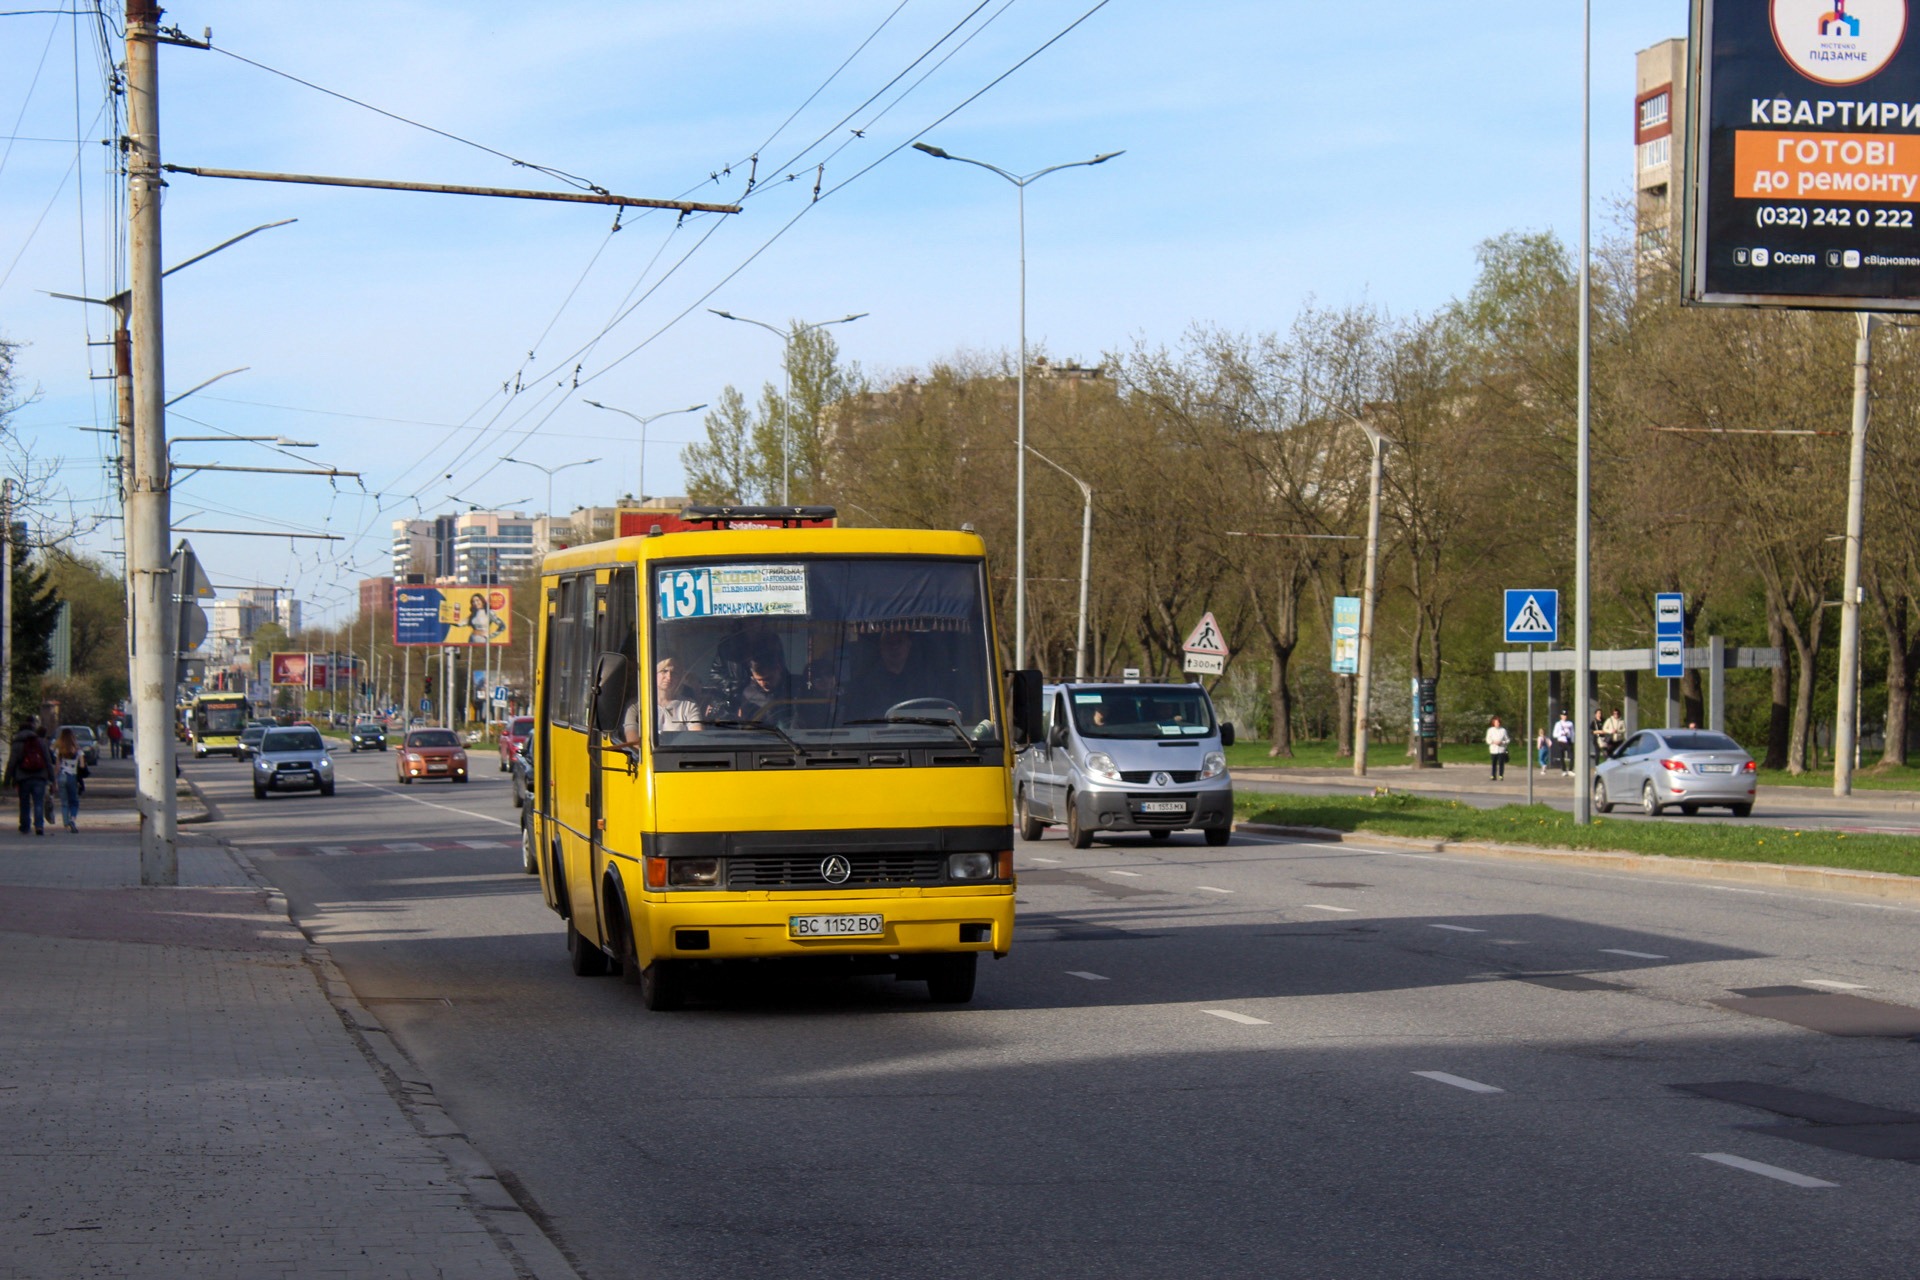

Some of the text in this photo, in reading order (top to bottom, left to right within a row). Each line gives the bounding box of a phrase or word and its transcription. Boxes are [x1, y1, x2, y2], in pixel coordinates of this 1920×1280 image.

[1809, 50, 1868, 62] ПІДЗАМЧЕ
[1751, 98, 1920, 127] КВАРТИРИ
[1777, 138, 1895, 166] ГОТОВІ
[1753, 170, 1919, 199] до ремонту
[1756, 206, 1913, 229] (032) 242 0 222
[1773, 251, 1816, 265] Оселя
[660, 571, 712, 618] 131
[713, 602, 763, 614] РЯСНА-РУСЬКА
[799, 917, 879, 933] BC 1152 BO
